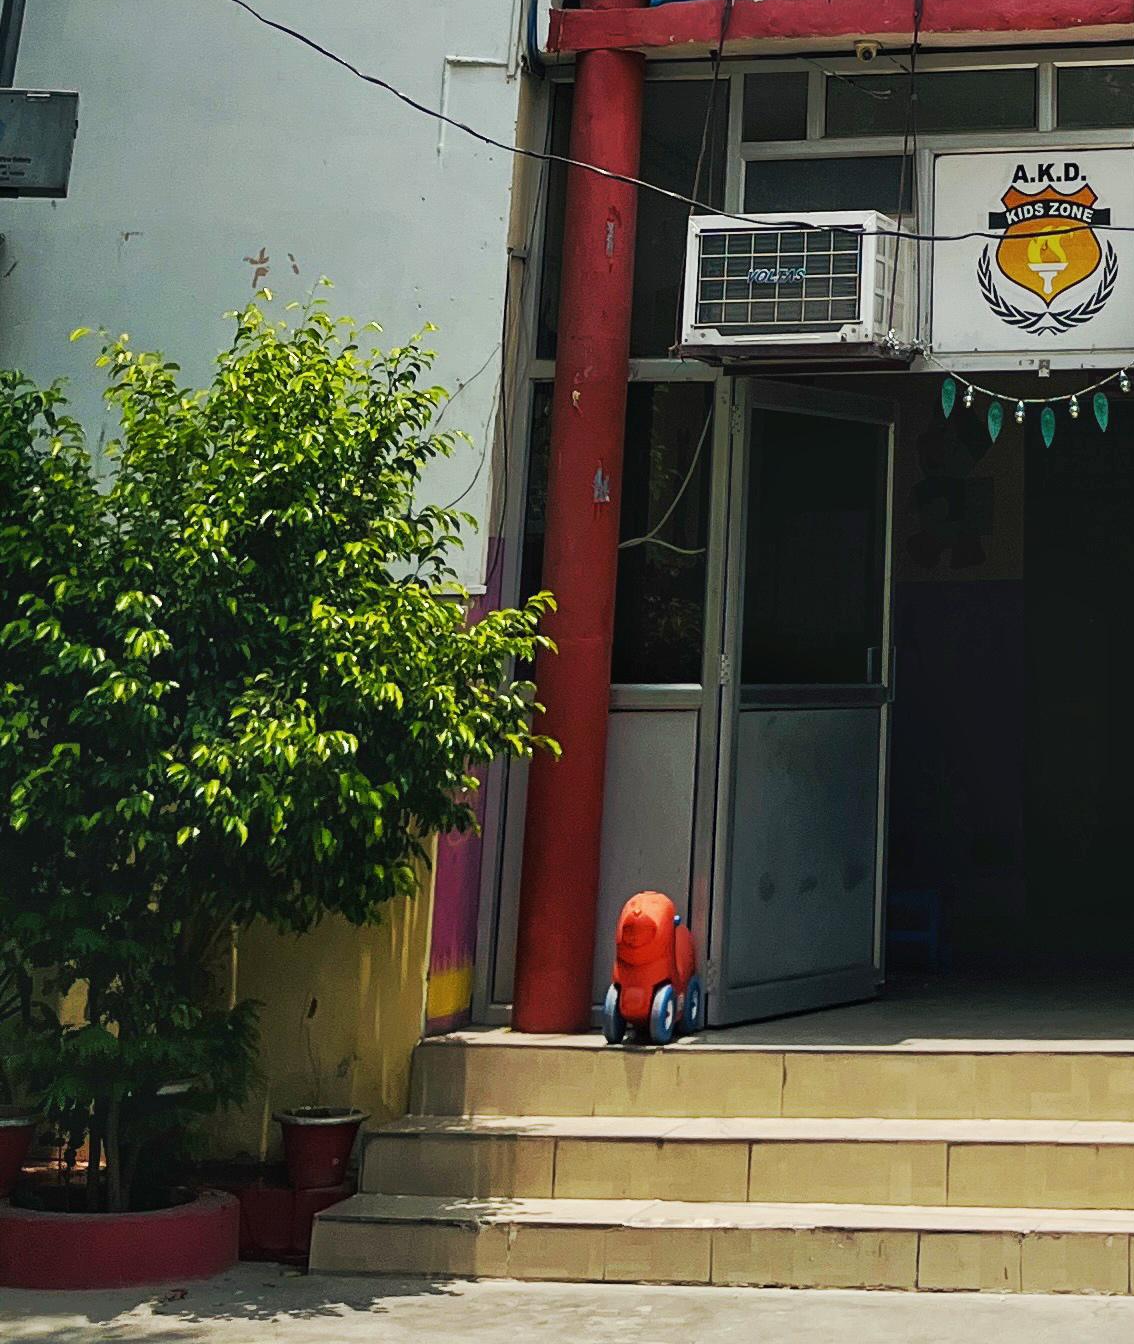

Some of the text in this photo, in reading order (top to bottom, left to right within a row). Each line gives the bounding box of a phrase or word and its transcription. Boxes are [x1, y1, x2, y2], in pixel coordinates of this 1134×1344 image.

[1011, 162, 1087, 183] A.K.D.
[1005, 202, 1094, 225] KIDS ZONE
[747, 268, 806, 284] VOLTAS
